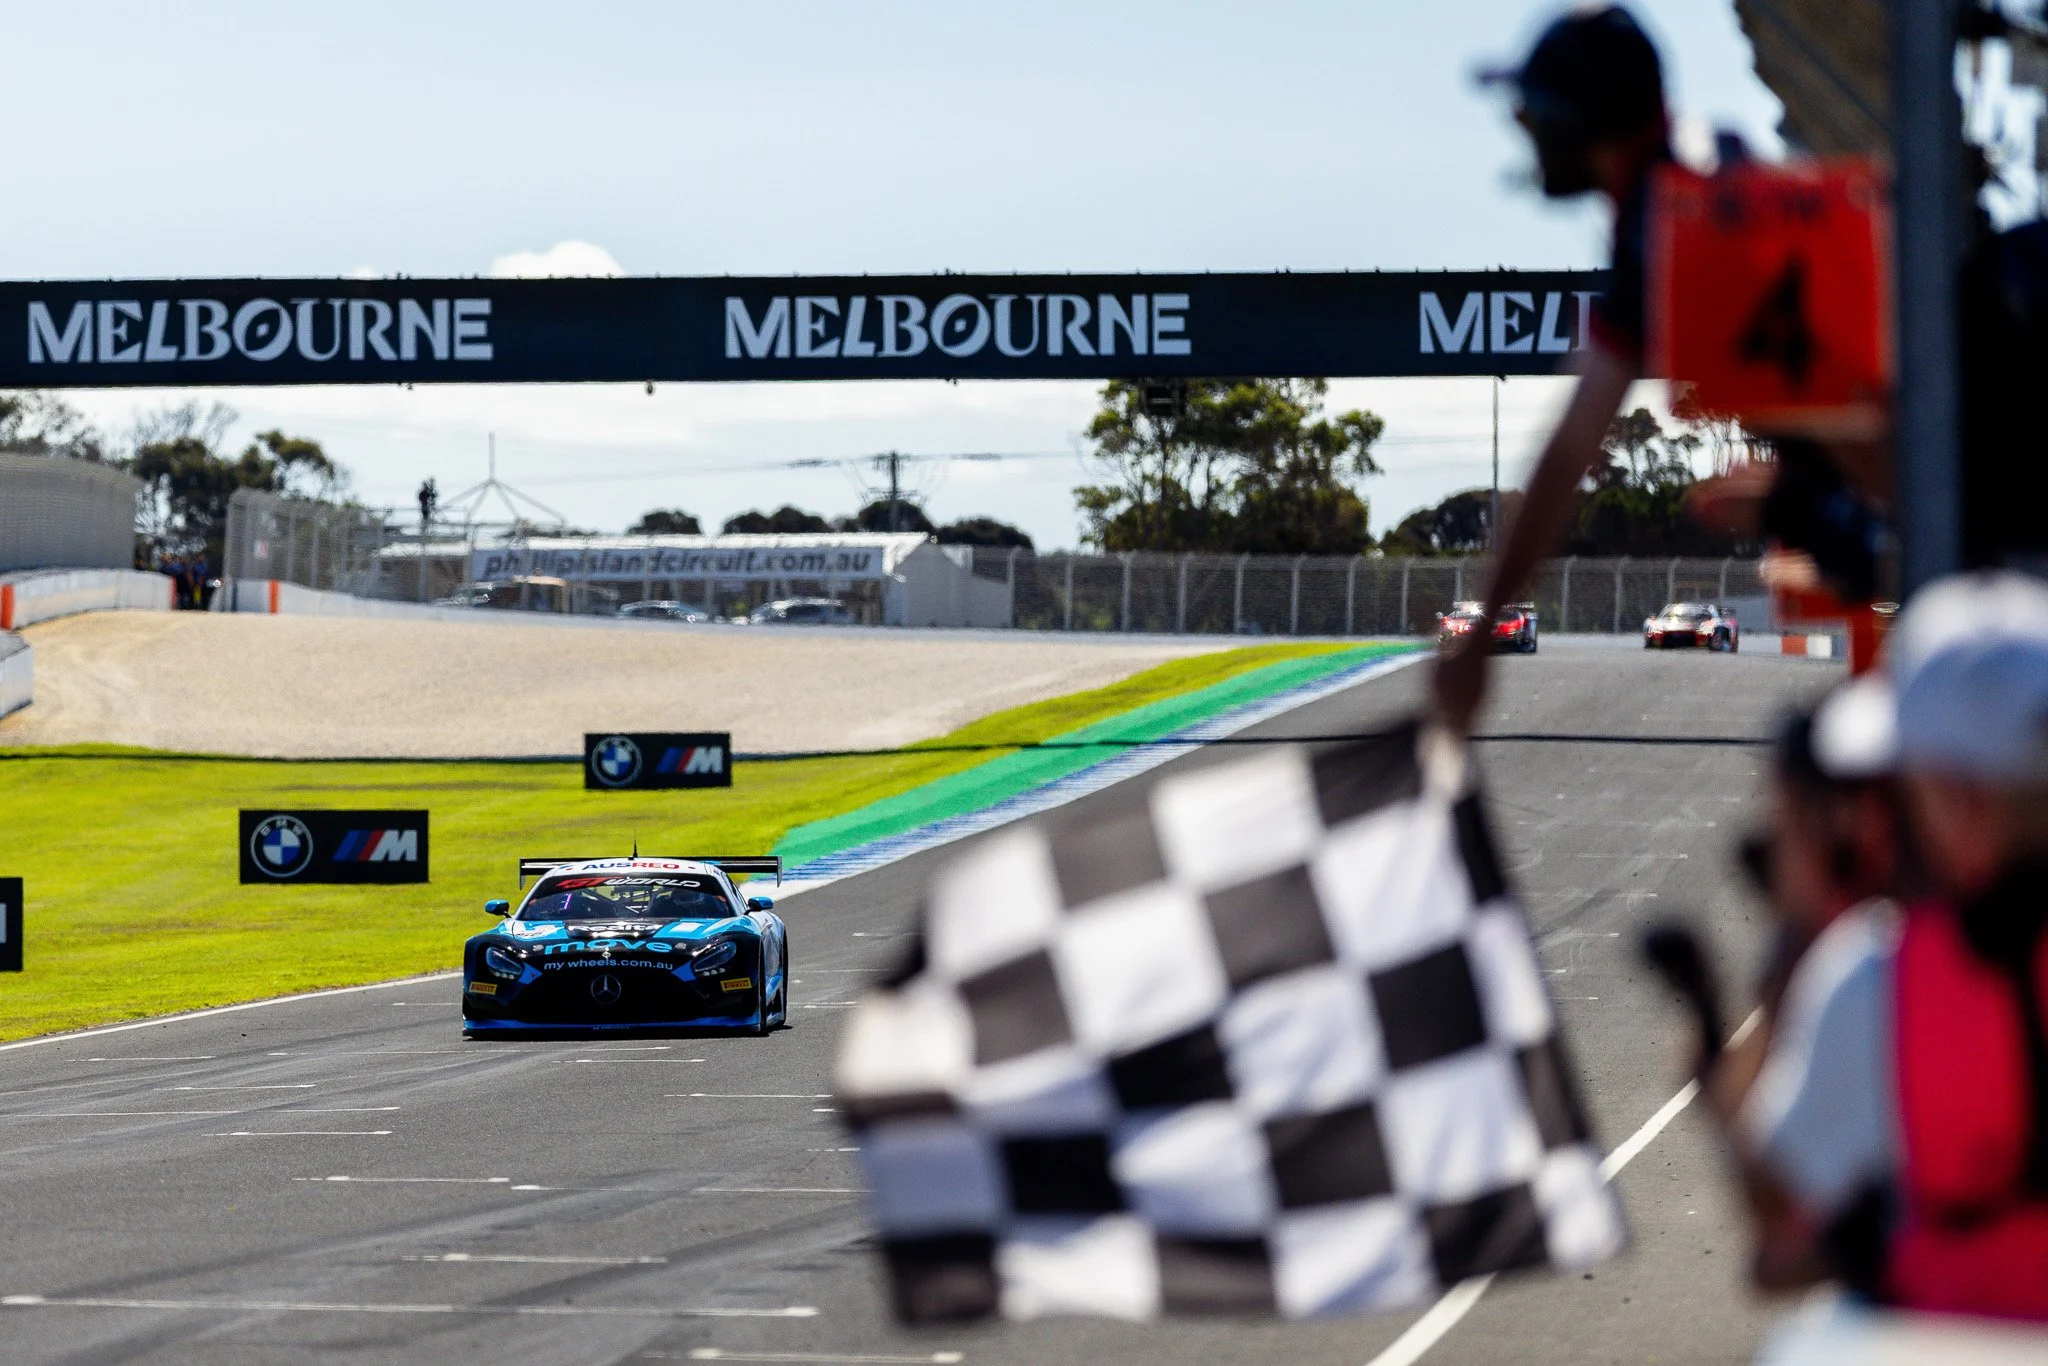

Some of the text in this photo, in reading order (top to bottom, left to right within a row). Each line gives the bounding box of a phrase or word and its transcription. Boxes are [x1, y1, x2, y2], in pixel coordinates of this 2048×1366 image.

[28, 299, 494, 363] MELBOURNE
[725, 294, 1193, 358] MELBOURNE
[1739, 250, 1821, 392] 4
[481, 548, 871, 582] phllipislandcircuit.com.au
[684, 746, 724, 775] M
[368, 829, 418, 862] M
[582, 862, 680, 871] AUSREO
[544, 939, 673, 955] move
[544, 957, 674, 971] my wheels.com.au
